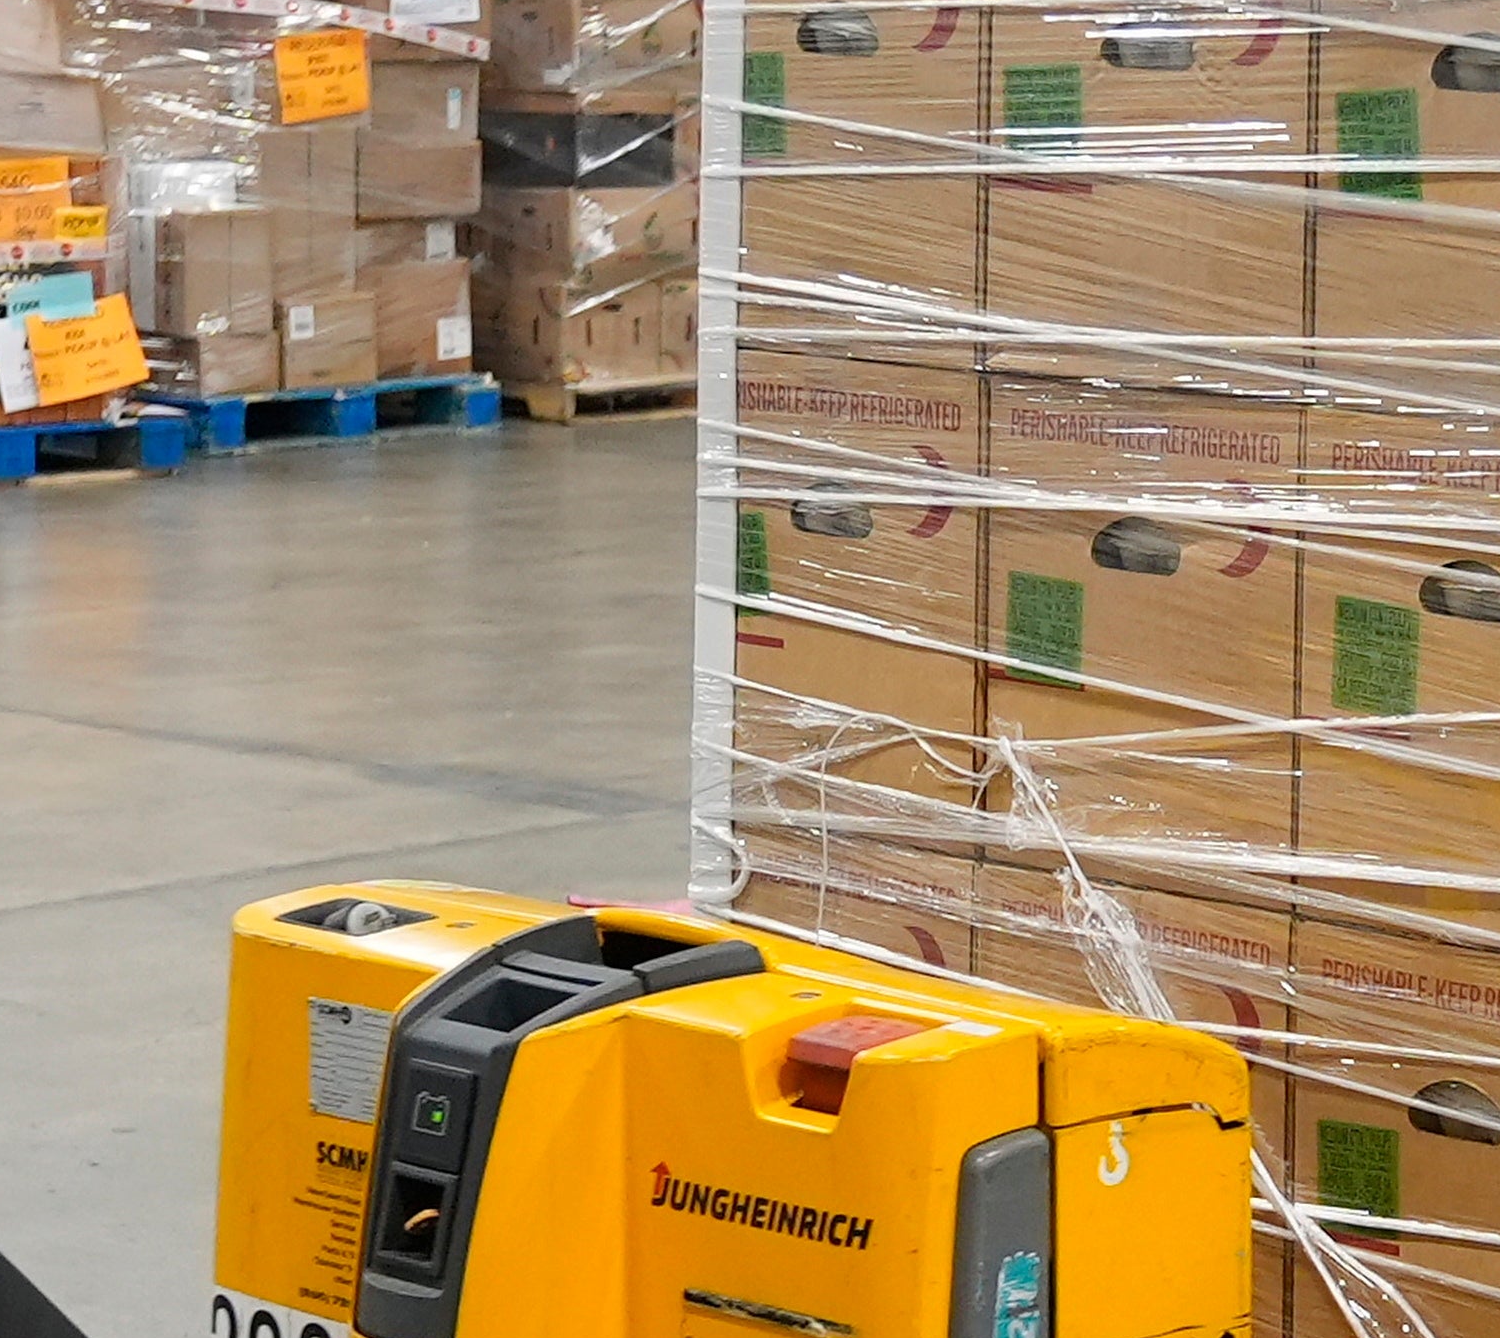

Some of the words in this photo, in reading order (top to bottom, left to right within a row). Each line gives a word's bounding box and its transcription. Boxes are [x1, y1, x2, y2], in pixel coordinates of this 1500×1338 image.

[740, 379, 847, 415] ISHABLE-KEEP
[849, 390, 962, 432] REFRIGERATED
[1161, 423, 1281, 465] REFRIGERATED
[650, 1175, 875, 1251] JUNGHEINRICH
